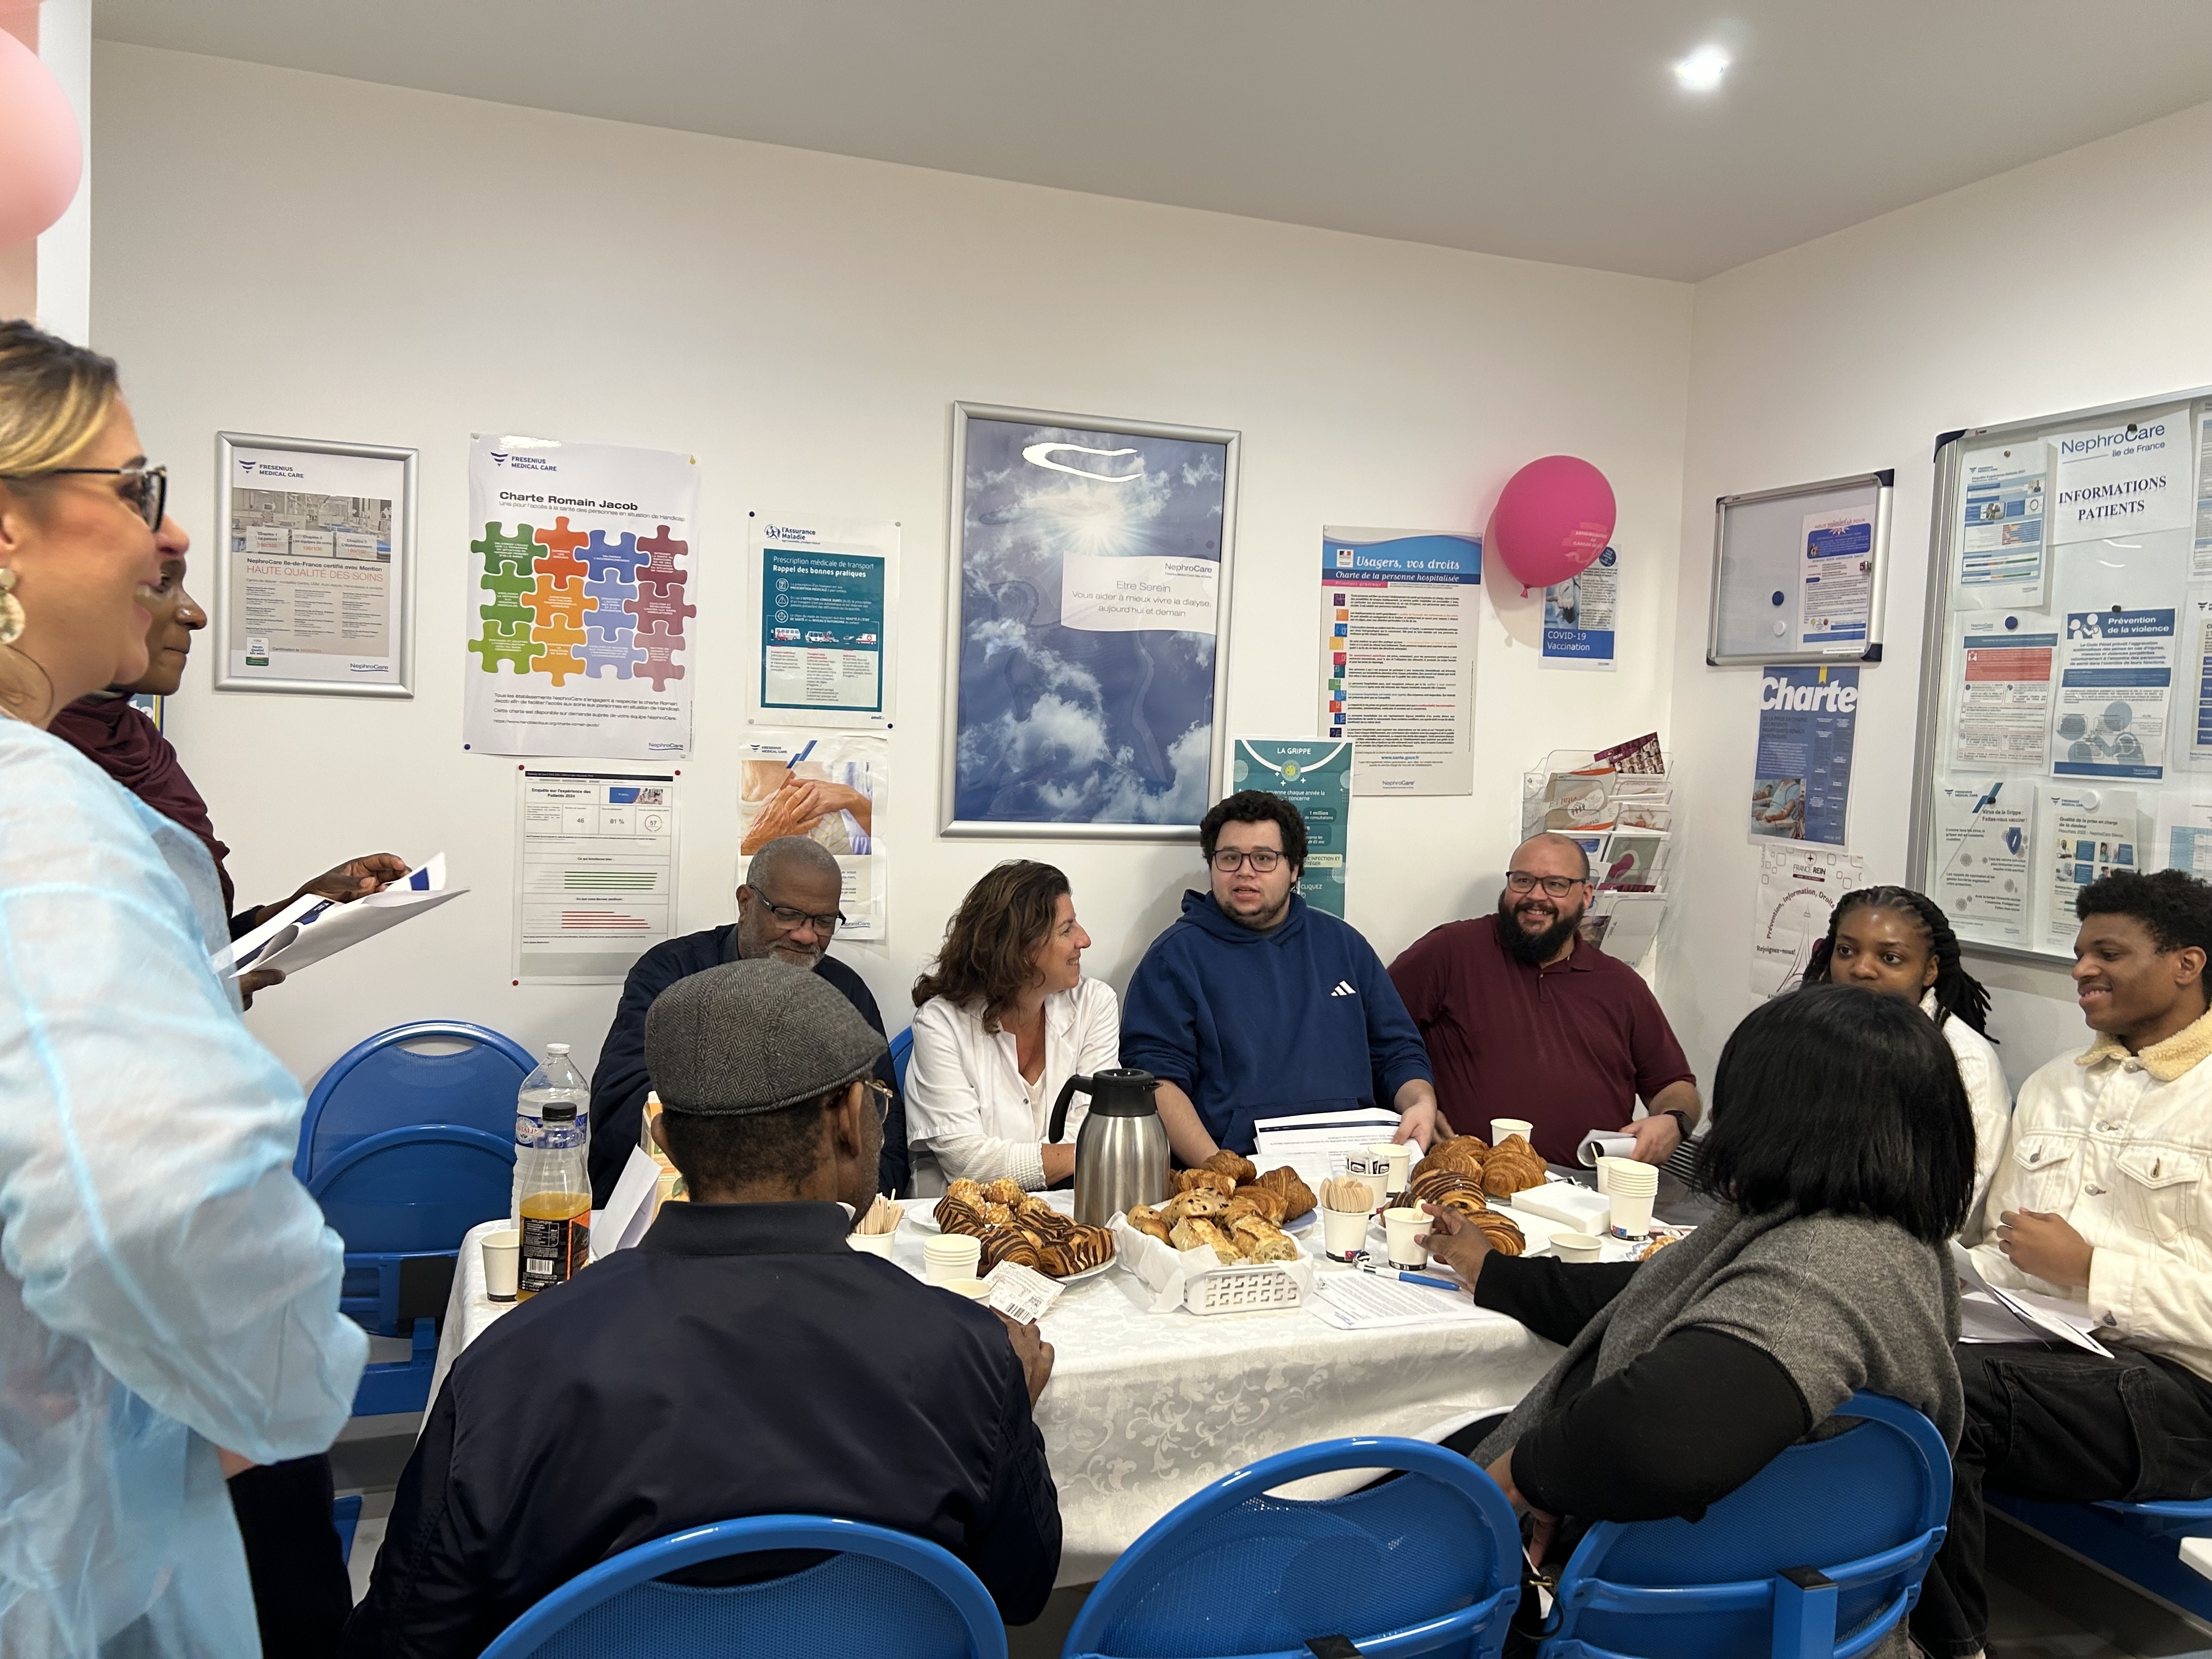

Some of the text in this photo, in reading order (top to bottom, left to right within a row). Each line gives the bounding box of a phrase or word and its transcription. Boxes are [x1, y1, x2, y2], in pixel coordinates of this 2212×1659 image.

[2062, 425, 2165, 454] NephroCare
[2137, 442, 2165, 453] France
[511, 456, 546, 464] FRESENIUS
[2059, 475, 2166, 504] INFORMATIONS
[499, 492, 638, 511] Charte Romain Jacob
[2078, 500, 2145, 521] PATIENTS
[782, 527, 816, 535] l'Assurance
[773, 556, 809, 565] Prescription
[848, 561, 874, 570] transport
[1165, 563, 1212, 573] NephroCare
[1357, 556, 1460, 570] Usagers, vos droits
[247, 565, 383, 582] HAUTE QUALITÉ DES SOINS
[773, 565, 795, 573] Rappel
[835, 569, 866, 578] pratiques
[1336, 571, 1360, 579] Charte
[1417, 573, 1459, 583] hospitalisée
[1116, 580, 1171, 592] Etre Serein
[1072, 591, 1093, 599] Vous
[1095, 592, 1117, 601] aider
[1126, 594, 1151, 603] mieux
[1182, 599, 1211, 608] dialyse,
[1098, 605, 1144, 614] aujourd'hui
[1155, 608, 1186, 617] demain
[2108, 617, 2156, 625] Prévention
[1548, 631, 1587, 640] COVID-19
[1547, 641, 1590, 651] Vaccination
[1761, 677, 1858, 713] Charte
[1793, 864, 1826, 875] FRANCE REIN
[1767, 887, 1836, 939] Prévention, Information, Droits
[1757, 945, 1796, 955] Rejoignez-nous!
